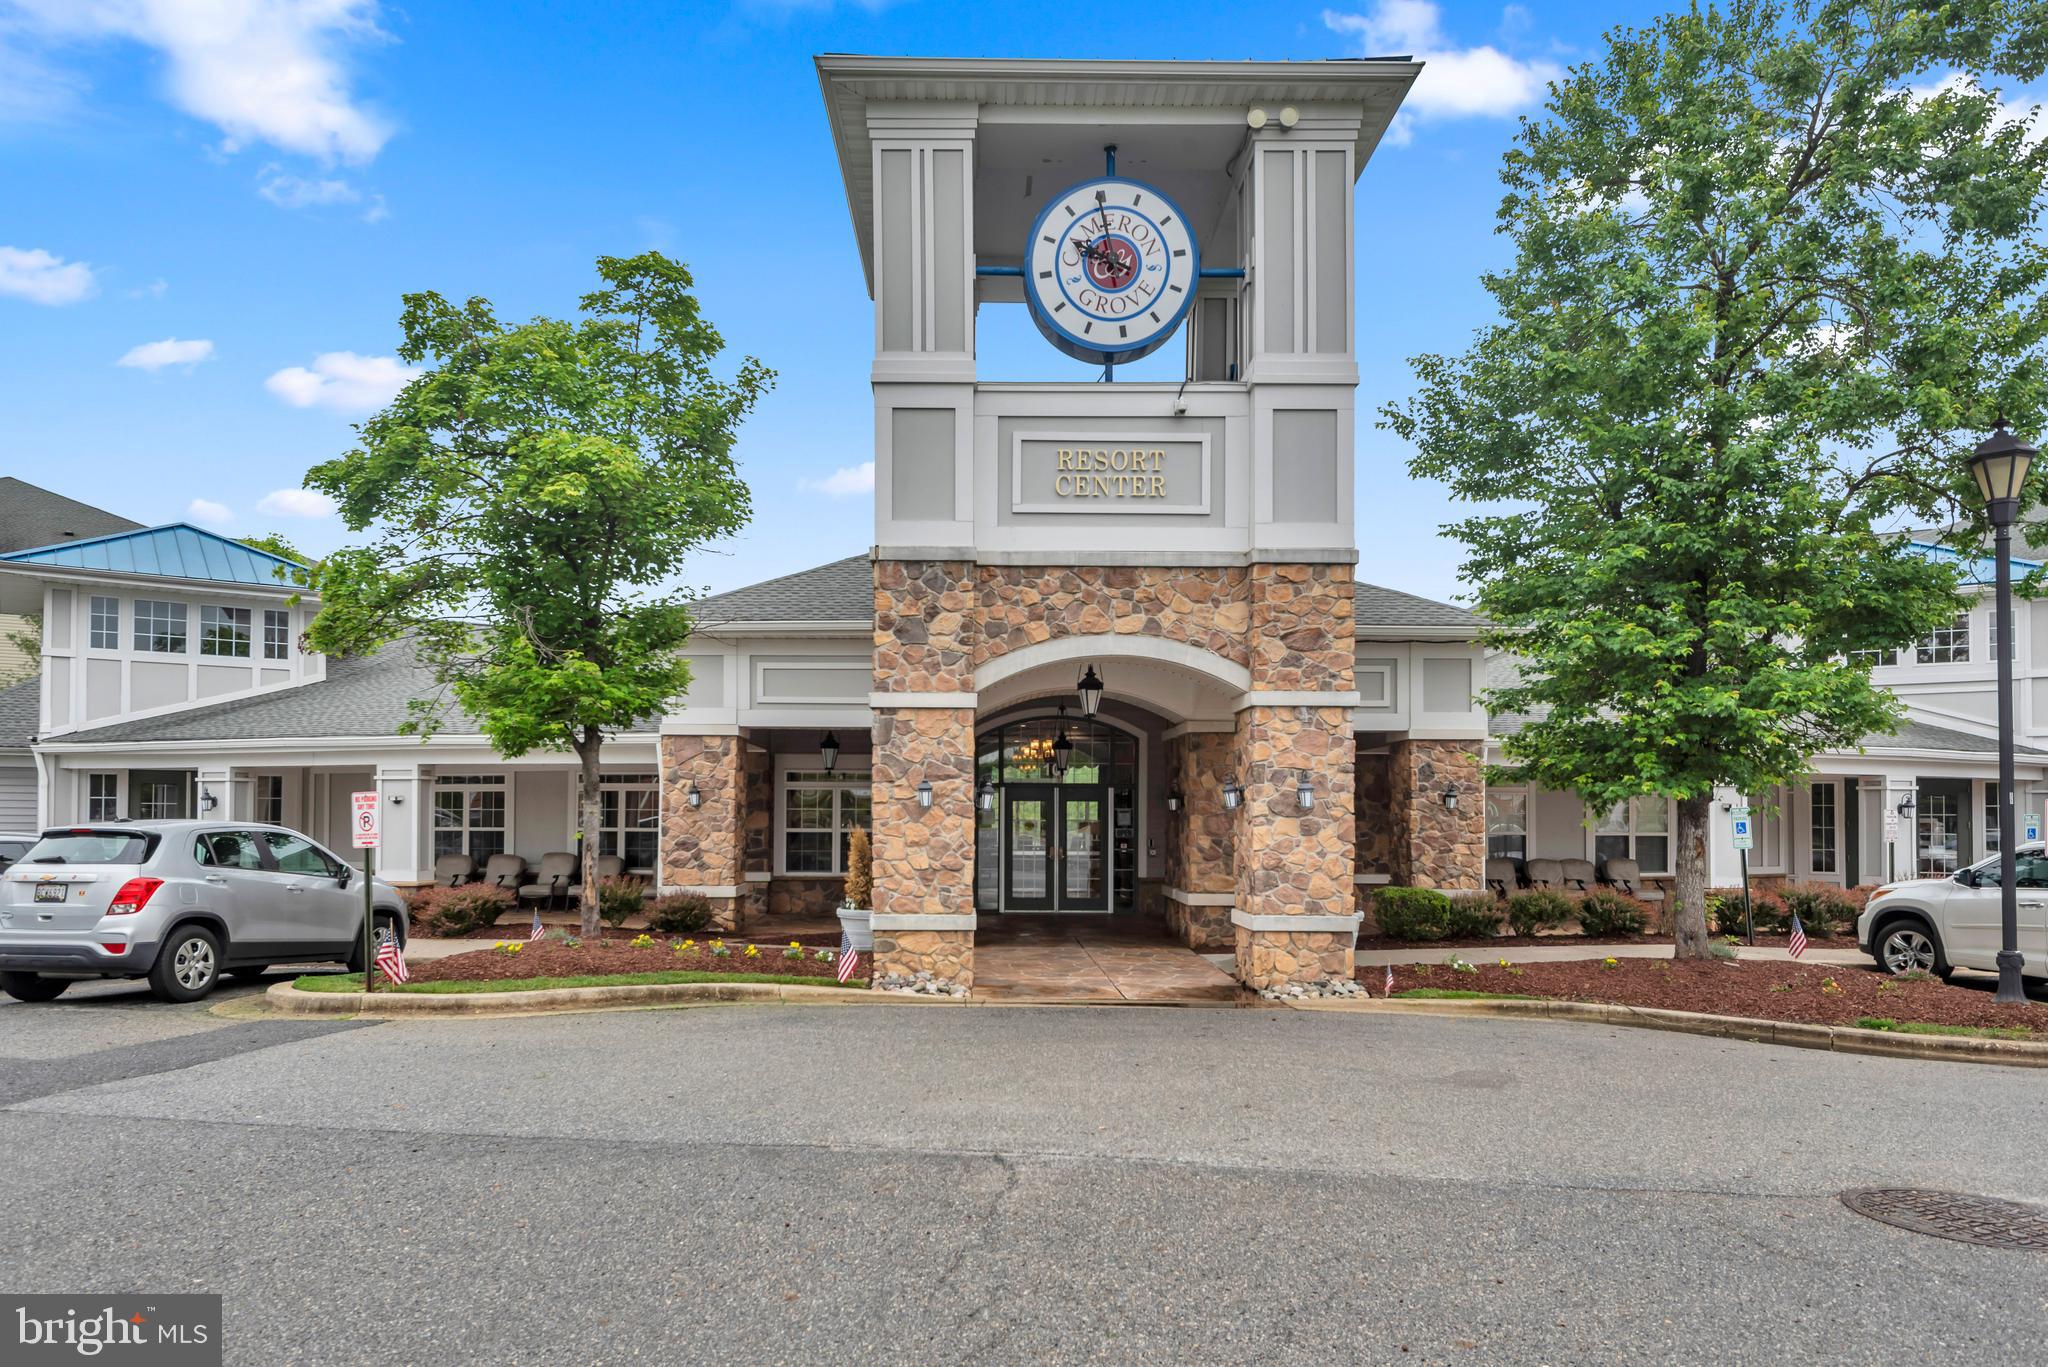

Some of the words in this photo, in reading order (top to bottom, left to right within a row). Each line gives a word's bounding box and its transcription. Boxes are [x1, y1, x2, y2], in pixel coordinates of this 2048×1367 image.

[1062, 213, 1161, 267] CAMERON
[1079, 279, 1156, 314] GROVE
[1057, 448, 1166, 471] RESORT
[1055, 474, 1167, 497] CENTER
